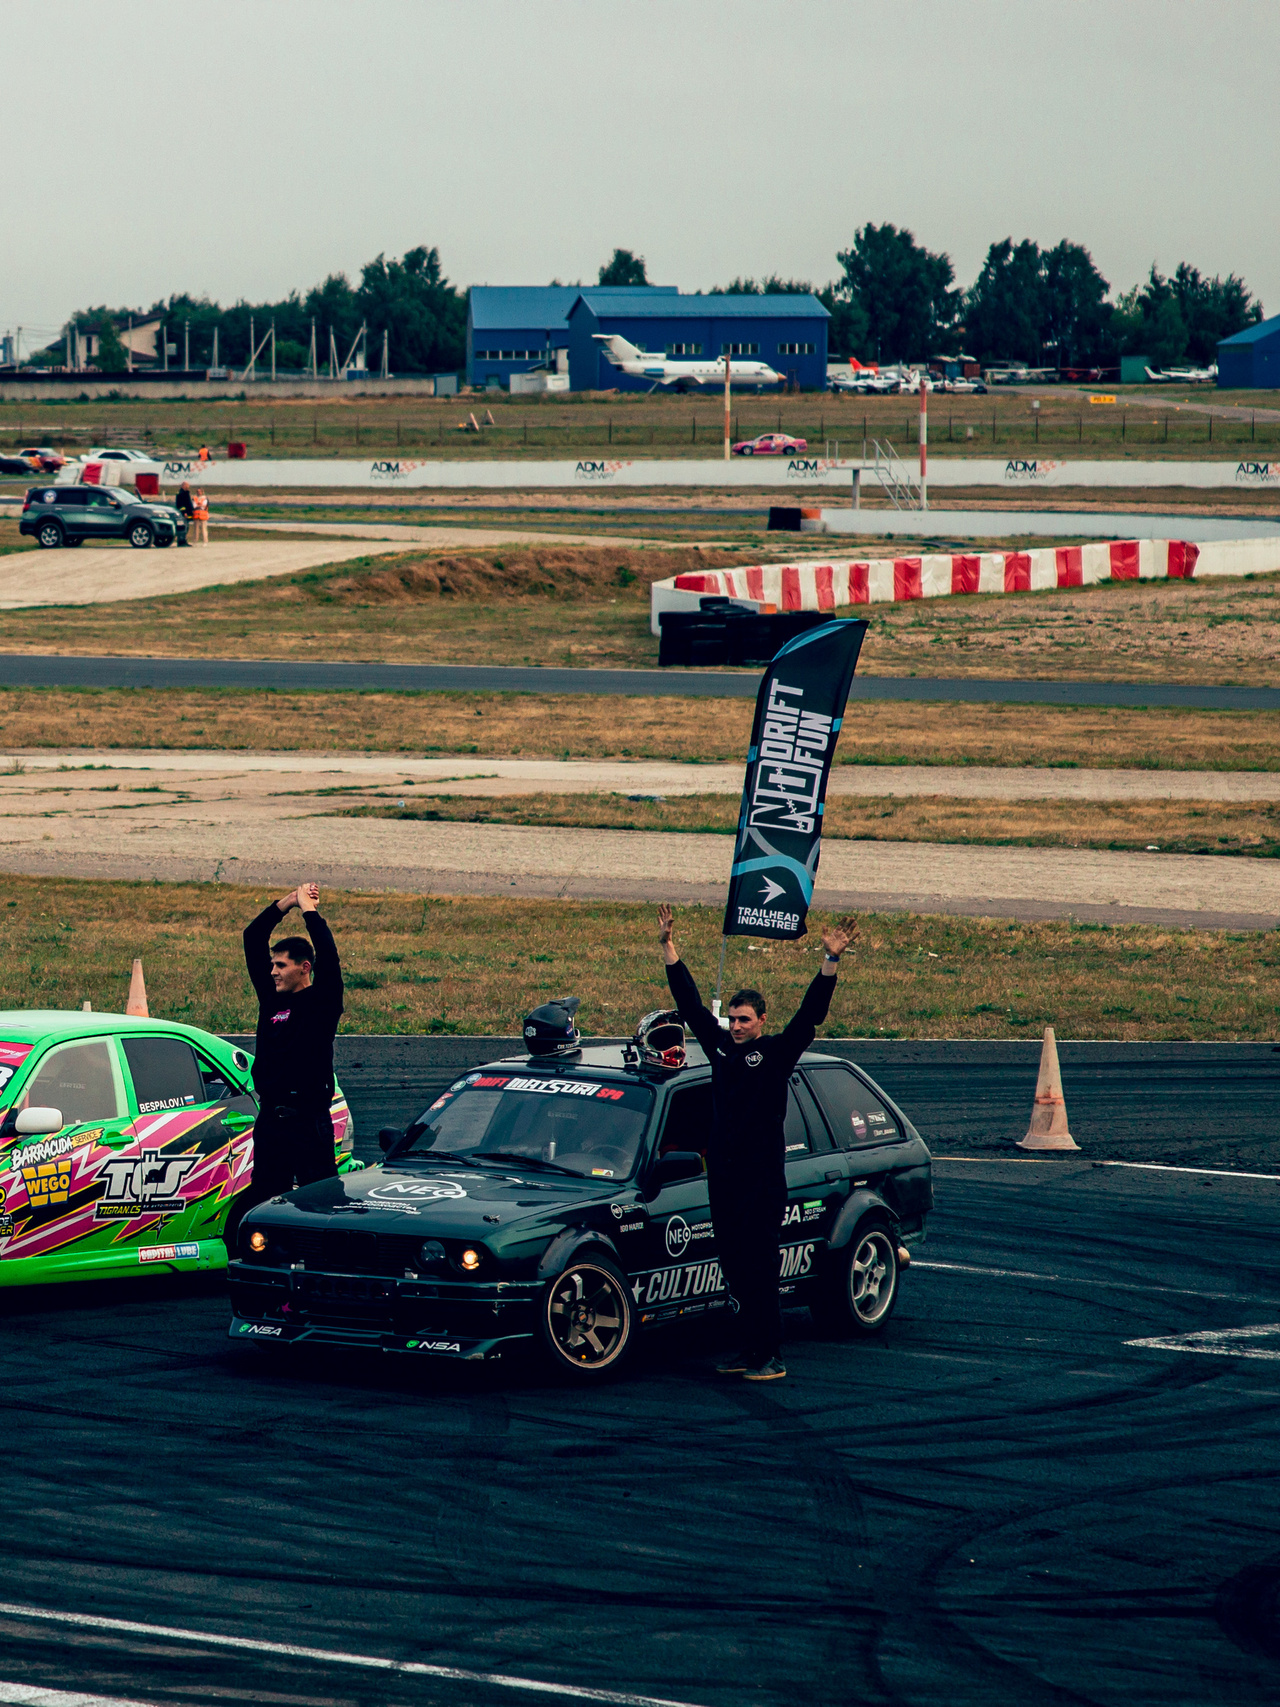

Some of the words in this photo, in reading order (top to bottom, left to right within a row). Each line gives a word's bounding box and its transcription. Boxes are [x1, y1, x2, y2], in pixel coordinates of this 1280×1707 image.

[164, 462, 191, 473] ADM
[371, 461, 400, 473] ADM
[575, 461, 605, 473] ADM
[787, 460, 818, 471] ADM
[1005, 460, 1037, 472] ADM
[1236, 462, 1269, 474] ADM
[759, 677, 805, 762] DRIFT
[793, 710, 834, 769] FUN
[737, 906, 801, 924] TRAILHEAD
[736, 915, 799, 932] INDASTREE
[504, 1077, 603, 1097] MATSURI
[596, 1087, 625, 1101] SPB
[138, 1096, 185, 1114] BESPALOV.I
[11, 1135, 73, 1172] BARRACUDA
[73, 1131, 98, 1145] SERVICE
[25, 1173, 71, 1196] WEGO
[102, 1156, 194, 1200] TCS
[99, 1204, 141, 1215] TIGRAN.CS
[140, 1248, 175, 1261] CAPITAL
[176, 1245, 197, 1256] LUBE
[646, 1262, 726, 1304] CULTURE
[247, 1324, 283, 1336] NSA
[418, 1340, 461, 1352] NSA
